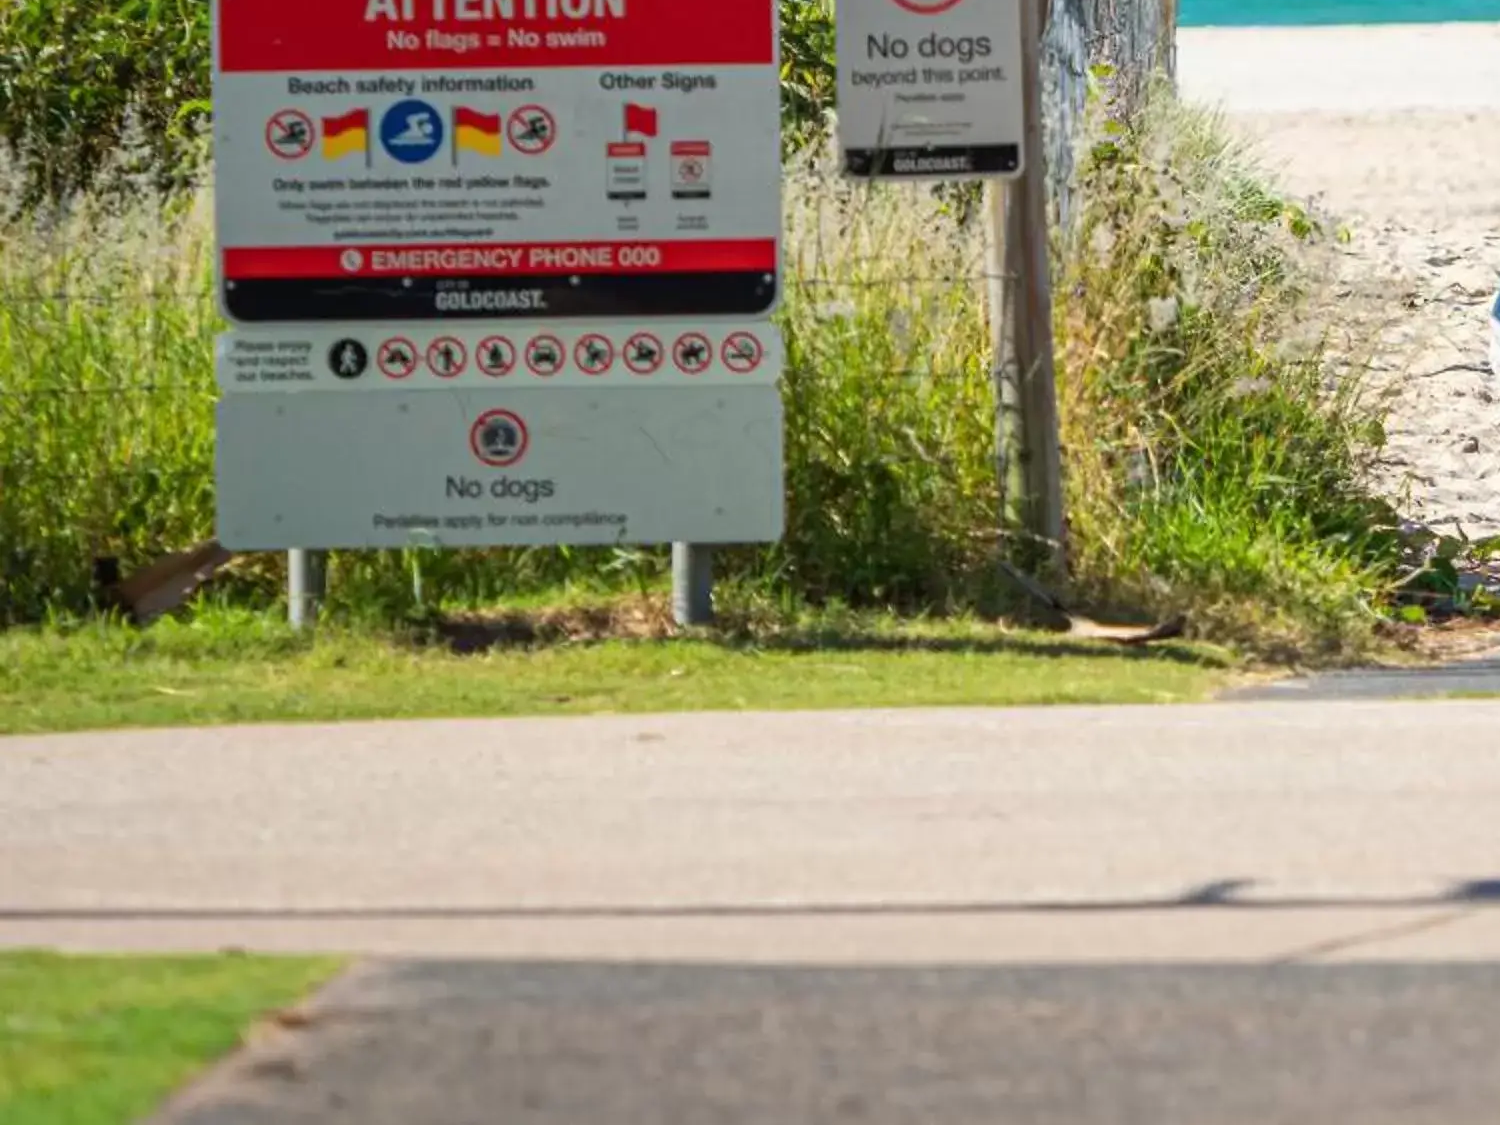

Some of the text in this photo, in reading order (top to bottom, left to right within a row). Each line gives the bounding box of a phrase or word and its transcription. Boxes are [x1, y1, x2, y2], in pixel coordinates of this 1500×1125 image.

[387, 30, 420, 50] No
[426, 28, 481, 53] flags
[507, 29, 541, 49] No
[545, 28, 606, 48] swim
[866, 32, 992, 64] No dogs
[288, 75, 534, 96] Beach safety information
[599, 72, 717, 93] Other Signs
[851, 66, 1008, 90] beyond this point.
[273, 178, 305, 193] Only
[309, 179, 345, 191] swim
[349, 177, 409, 191] between
[412, 176, 436, 190] the
[438, 176, 462, 189] red
[466, 175, 509, 191] yellow
[371, 244, 662, 271] EMERGENCY PHONE 000
[445, 475, 555, 503] No dogs
[373, 510, 628, 531] Penalties apply for non compliance
